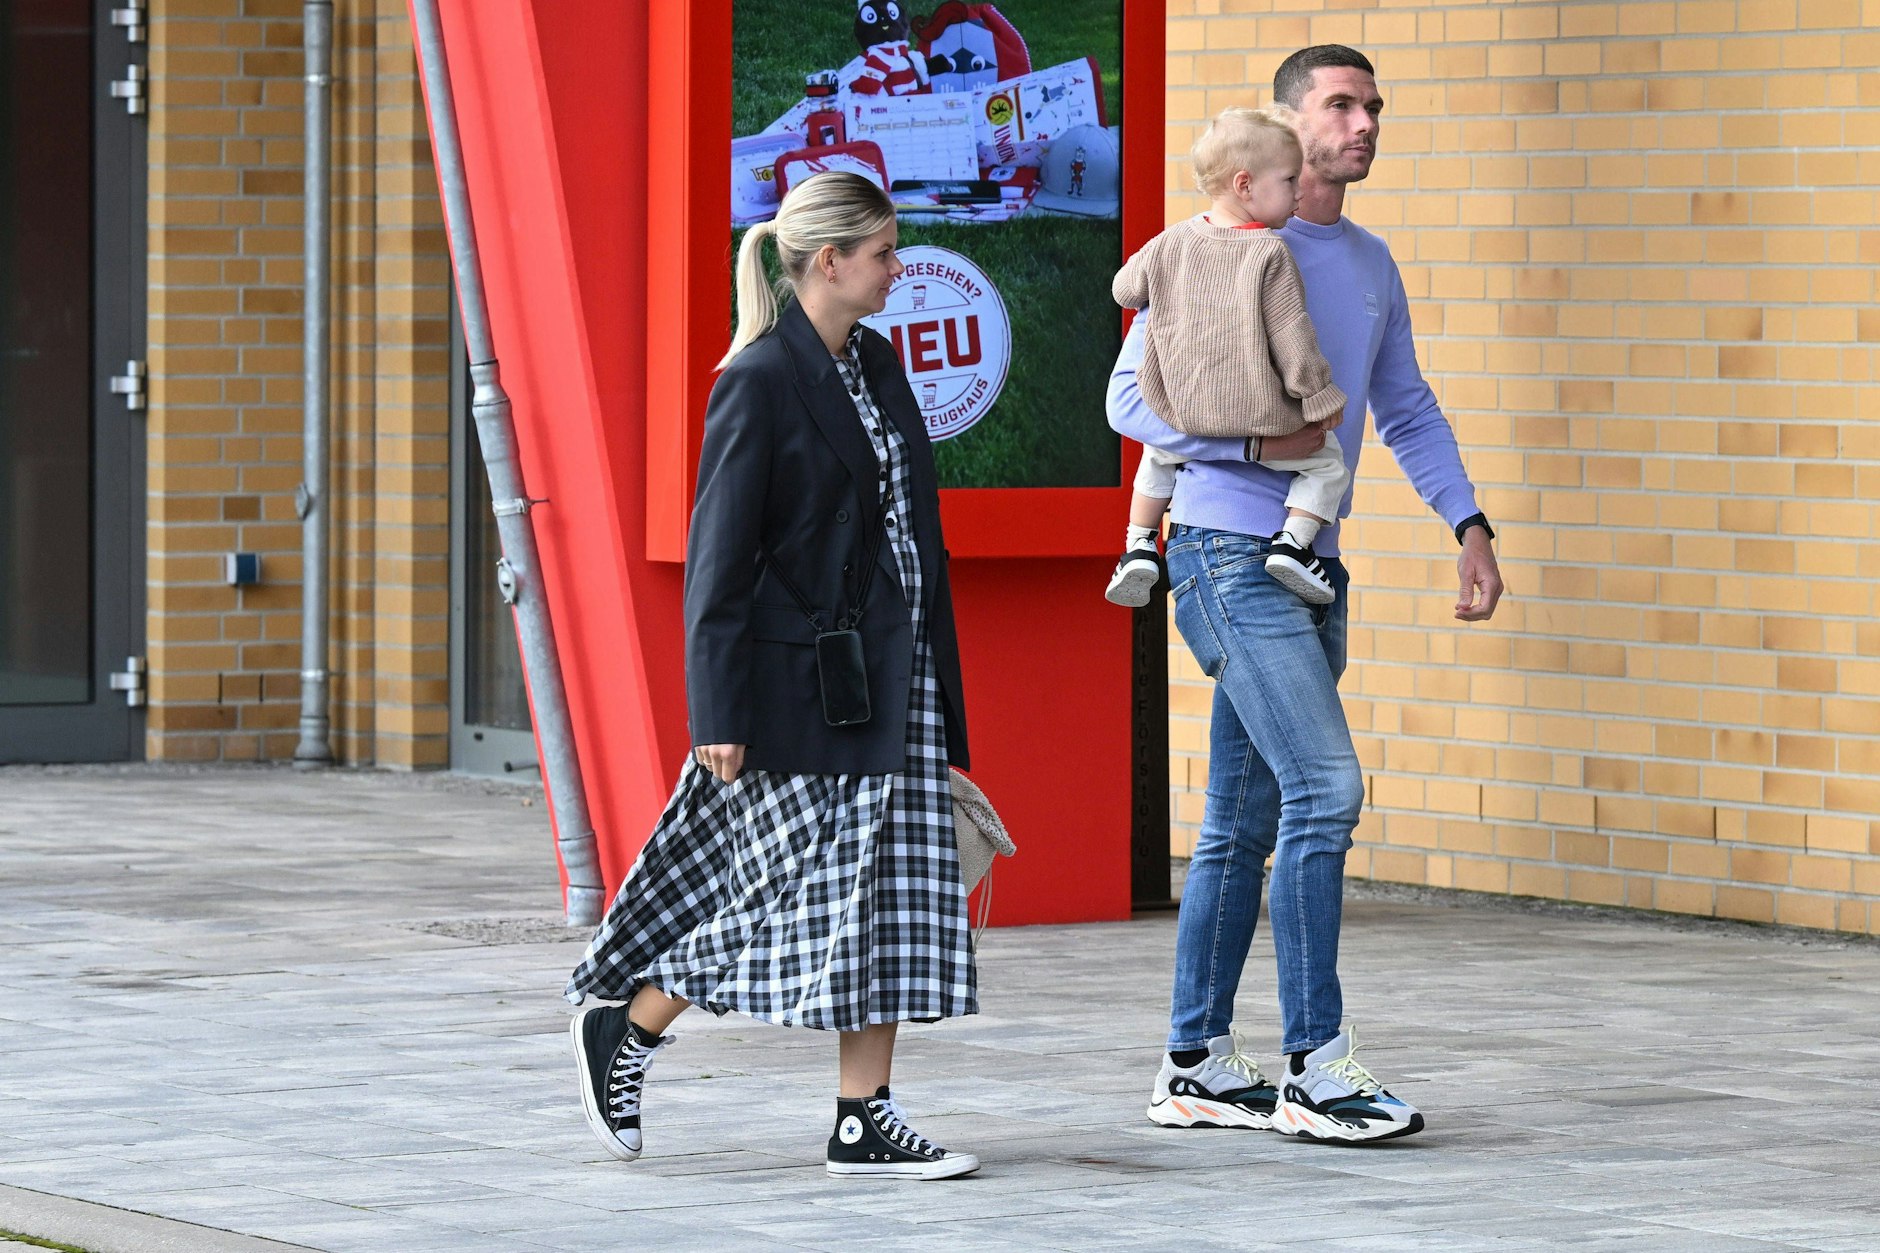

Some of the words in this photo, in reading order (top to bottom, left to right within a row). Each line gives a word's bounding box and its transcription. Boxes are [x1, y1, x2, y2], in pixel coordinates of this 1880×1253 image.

[870, 106, 888, 114] MEIN
[994, 124, 1016, 164] UNION
[905, 262, 982, 298] GESEHEN?
